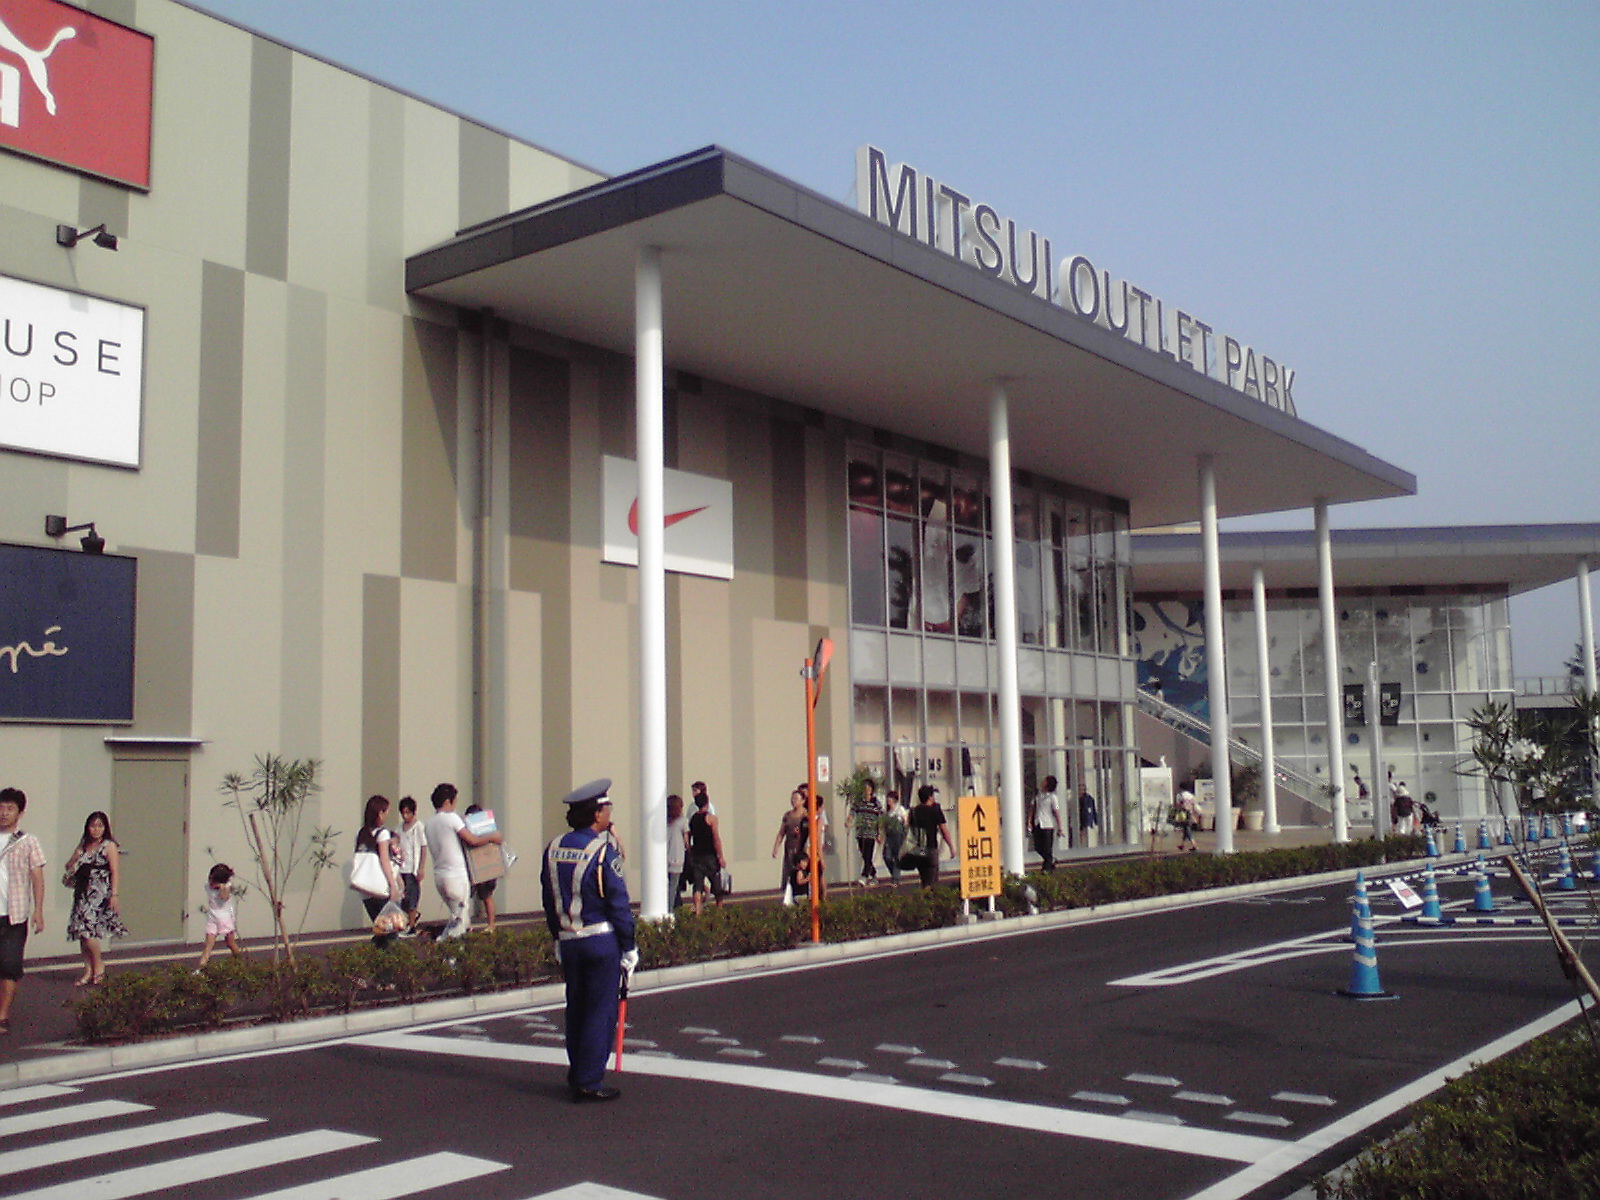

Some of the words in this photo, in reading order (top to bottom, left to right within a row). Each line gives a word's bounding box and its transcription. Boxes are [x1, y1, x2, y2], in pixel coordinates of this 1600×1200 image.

[856, 144, 1052, 302] MITSUI
[1058, 255, 1213, 376] OUTLET
[1216, 334, 1298, 419] PARK
[0, 374, 56, 406] OP
[967, 837, 993, 860] 出口
